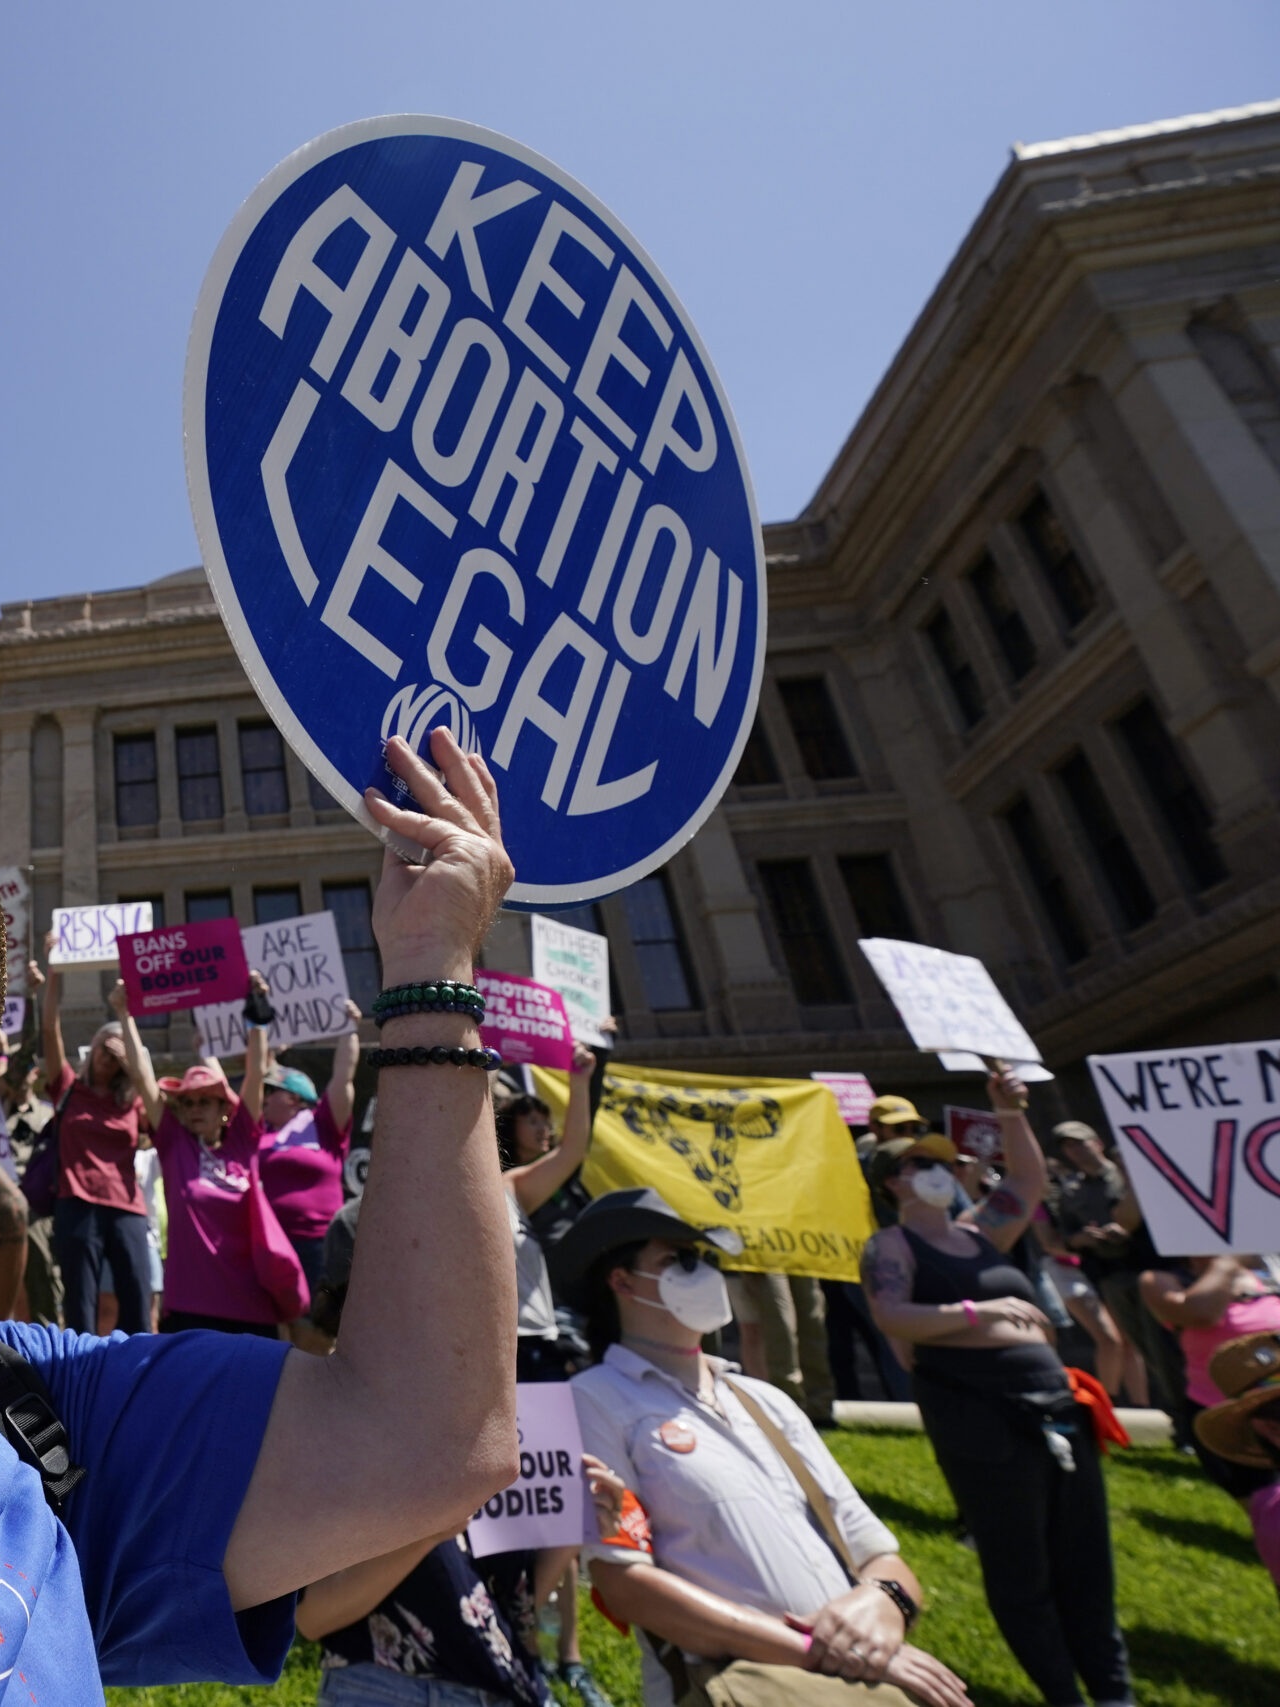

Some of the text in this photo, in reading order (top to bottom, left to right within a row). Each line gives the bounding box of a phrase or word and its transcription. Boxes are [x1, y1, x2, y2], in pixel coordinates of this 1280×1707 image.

[425, 161, 717, 475] KEEP
[258, 183, 743, 729] ABORTION
[260, 377, 661, 816] LEGAL
[132, 932, 188, 955] BANS
[262, 922, 320, 962] ARE
[135, 952, 176, 974] OFF
[179, 946, 227, 966] OUR
[256, 952, 334, 998] YOUR
[140, 965, 219, 991] BODIES
[474, 976, 552, 1006] PROTECT
[203, 993, 351, 1056] HAMAIDS
[480, 1011, 564, 1041] BORTION
[516, 1000, 567, 1027] LEGAL
[1096, 1054, 1243, 1113] WE'RE
[734, 1224, 797, 1255] EAD
[799, 1230, 842, 1258] ON
[520, 1450, 574, 1481] OUR
